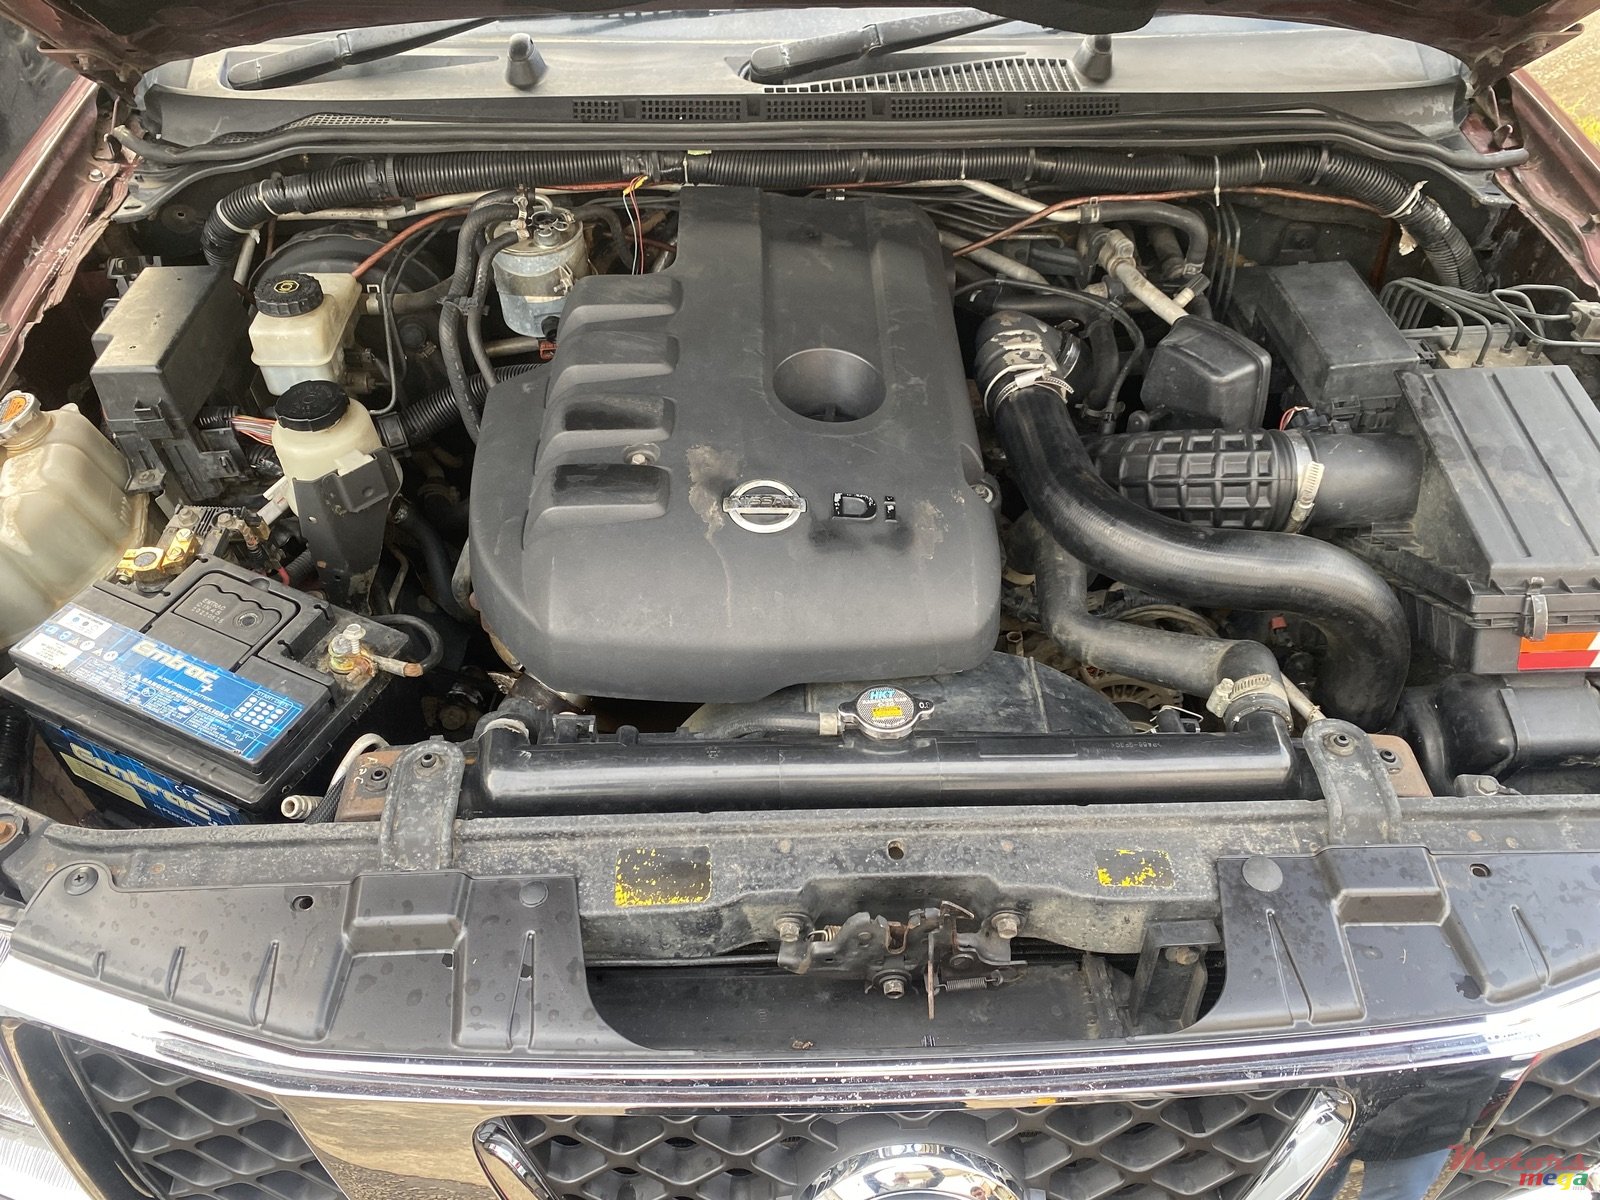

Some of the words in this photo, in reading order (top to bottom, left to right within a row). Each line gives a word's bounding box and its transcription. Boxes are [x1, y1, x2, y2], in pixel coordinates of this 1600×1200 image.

[730, 495, 797, 508] NISSAN
[832, 492, 898, 523] Di
[131, 640, 220, 685] Emtrac
[868, 690, 896, 700] HKT
[69, 742, 212, 822] Emtrac
